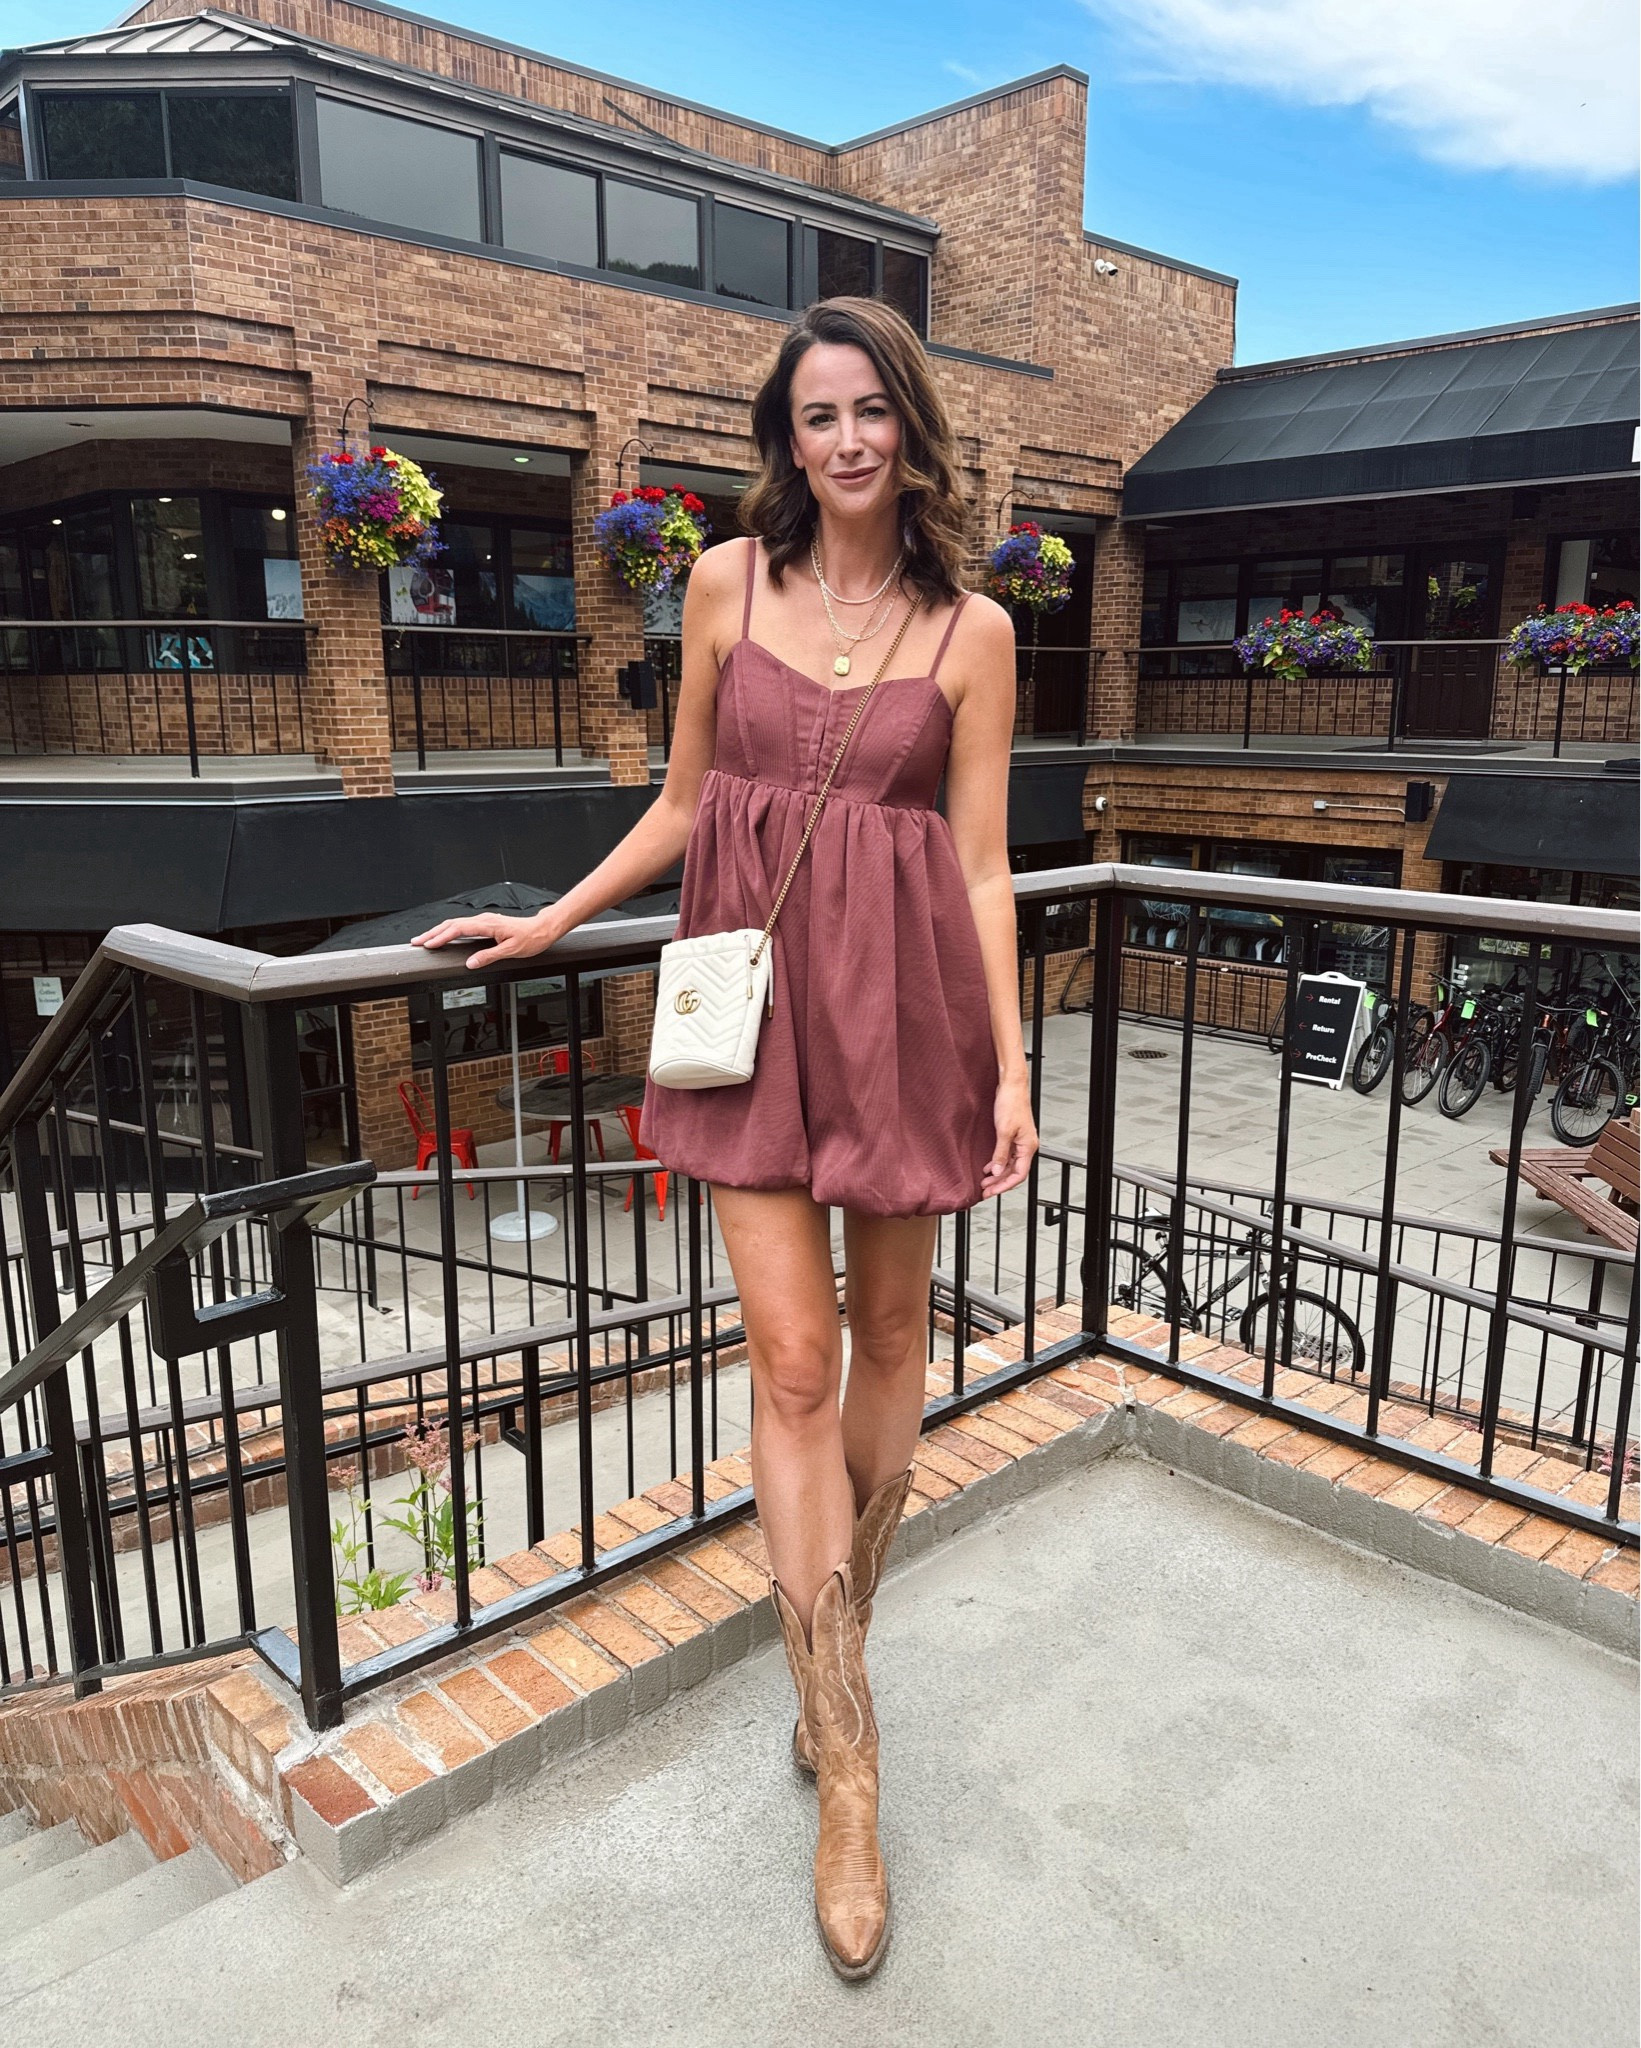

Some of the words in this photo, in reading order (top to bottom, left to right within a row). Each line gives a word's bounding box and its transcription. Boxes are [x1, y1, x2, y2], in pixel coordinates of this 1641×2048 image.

[1318, 995, 1341, 1005] Rental
[1312, 1024, 1335, 1034] Return
[1305, 1052, 1337, 1064] PreCheck
